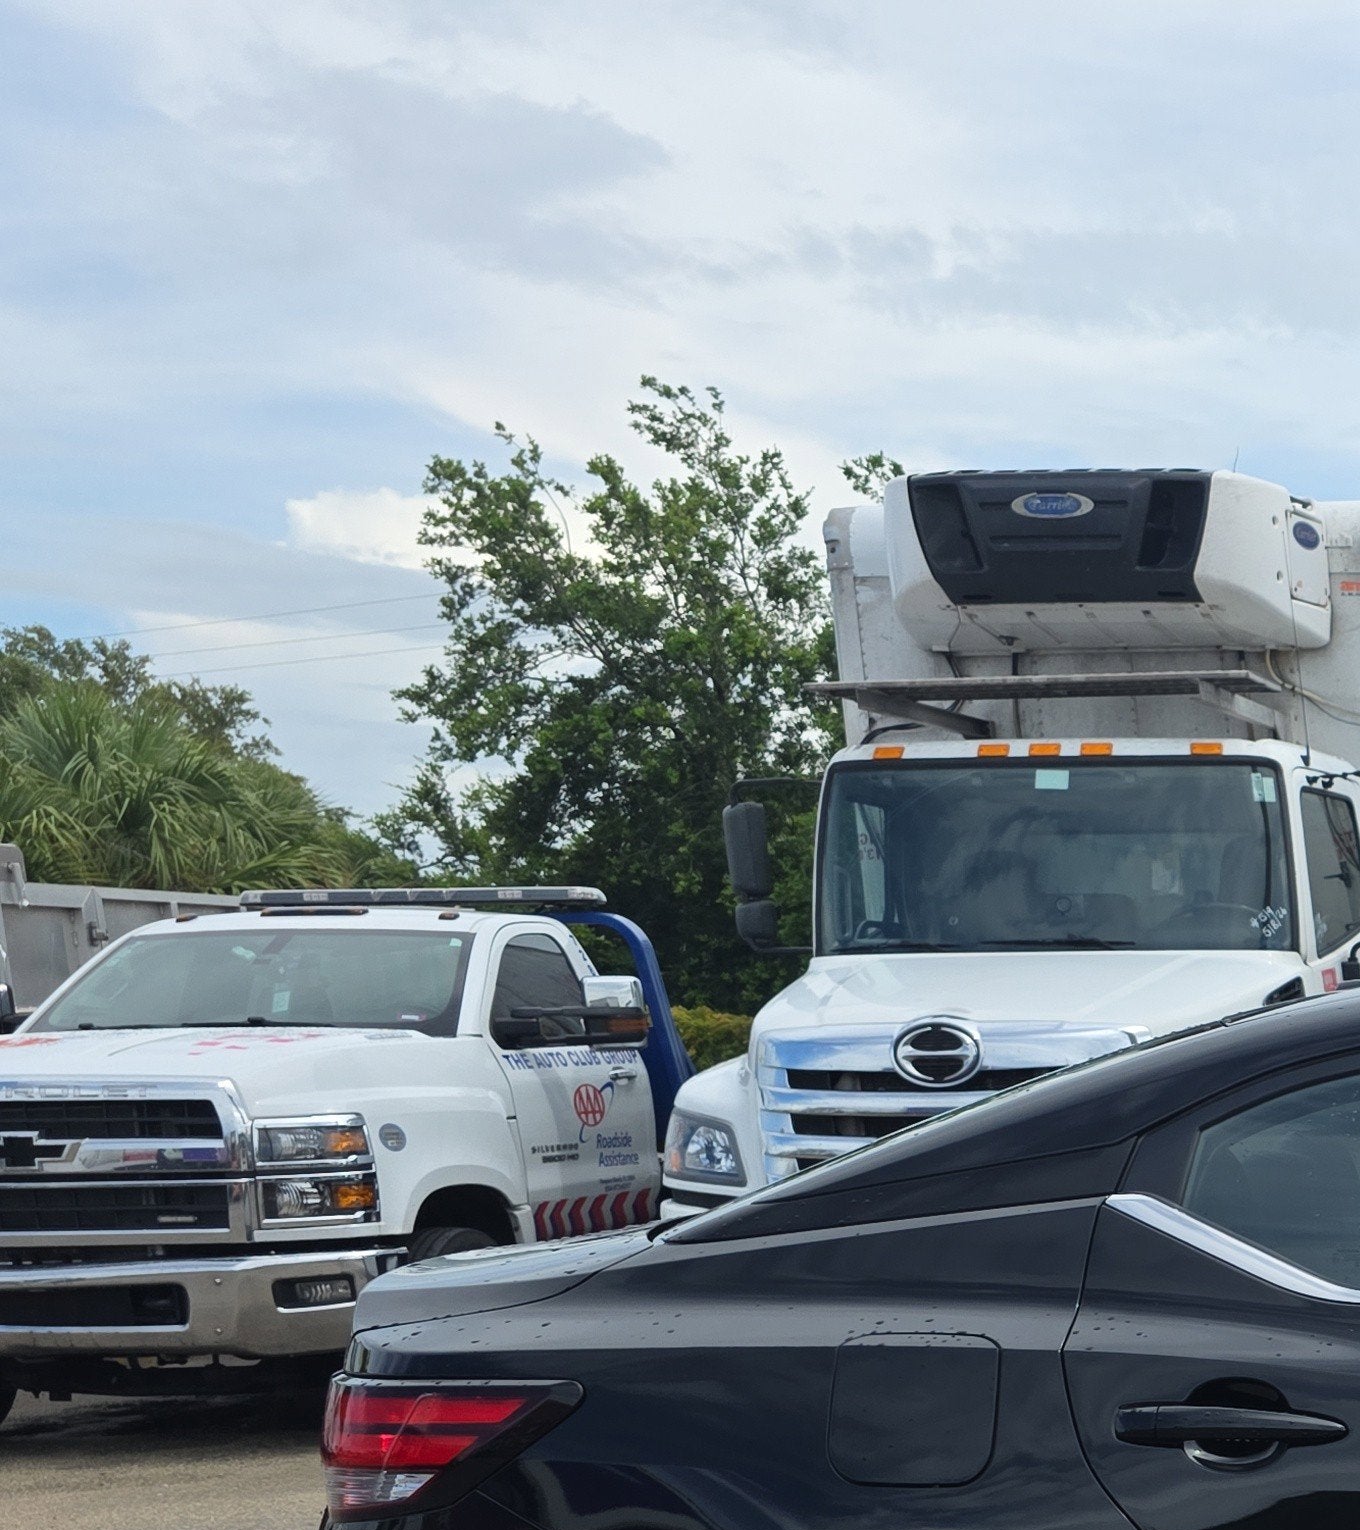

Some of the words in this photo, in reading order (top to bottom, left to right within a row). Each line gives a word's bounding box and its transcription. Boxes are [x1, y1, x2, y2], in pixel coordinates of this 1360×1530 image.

[502, 1053, 533, 1071] THE
[532, 1052, 567, 1069] AUTO
[568, 1050, 601, 1066] CLUB
[601, 1049, 637, 1065] GROUP
[576, 1085, 604, 1125] AAA
[596, 1132, 632, 1149] Roadside
[599, 1151, 640, 1168] Assistance
